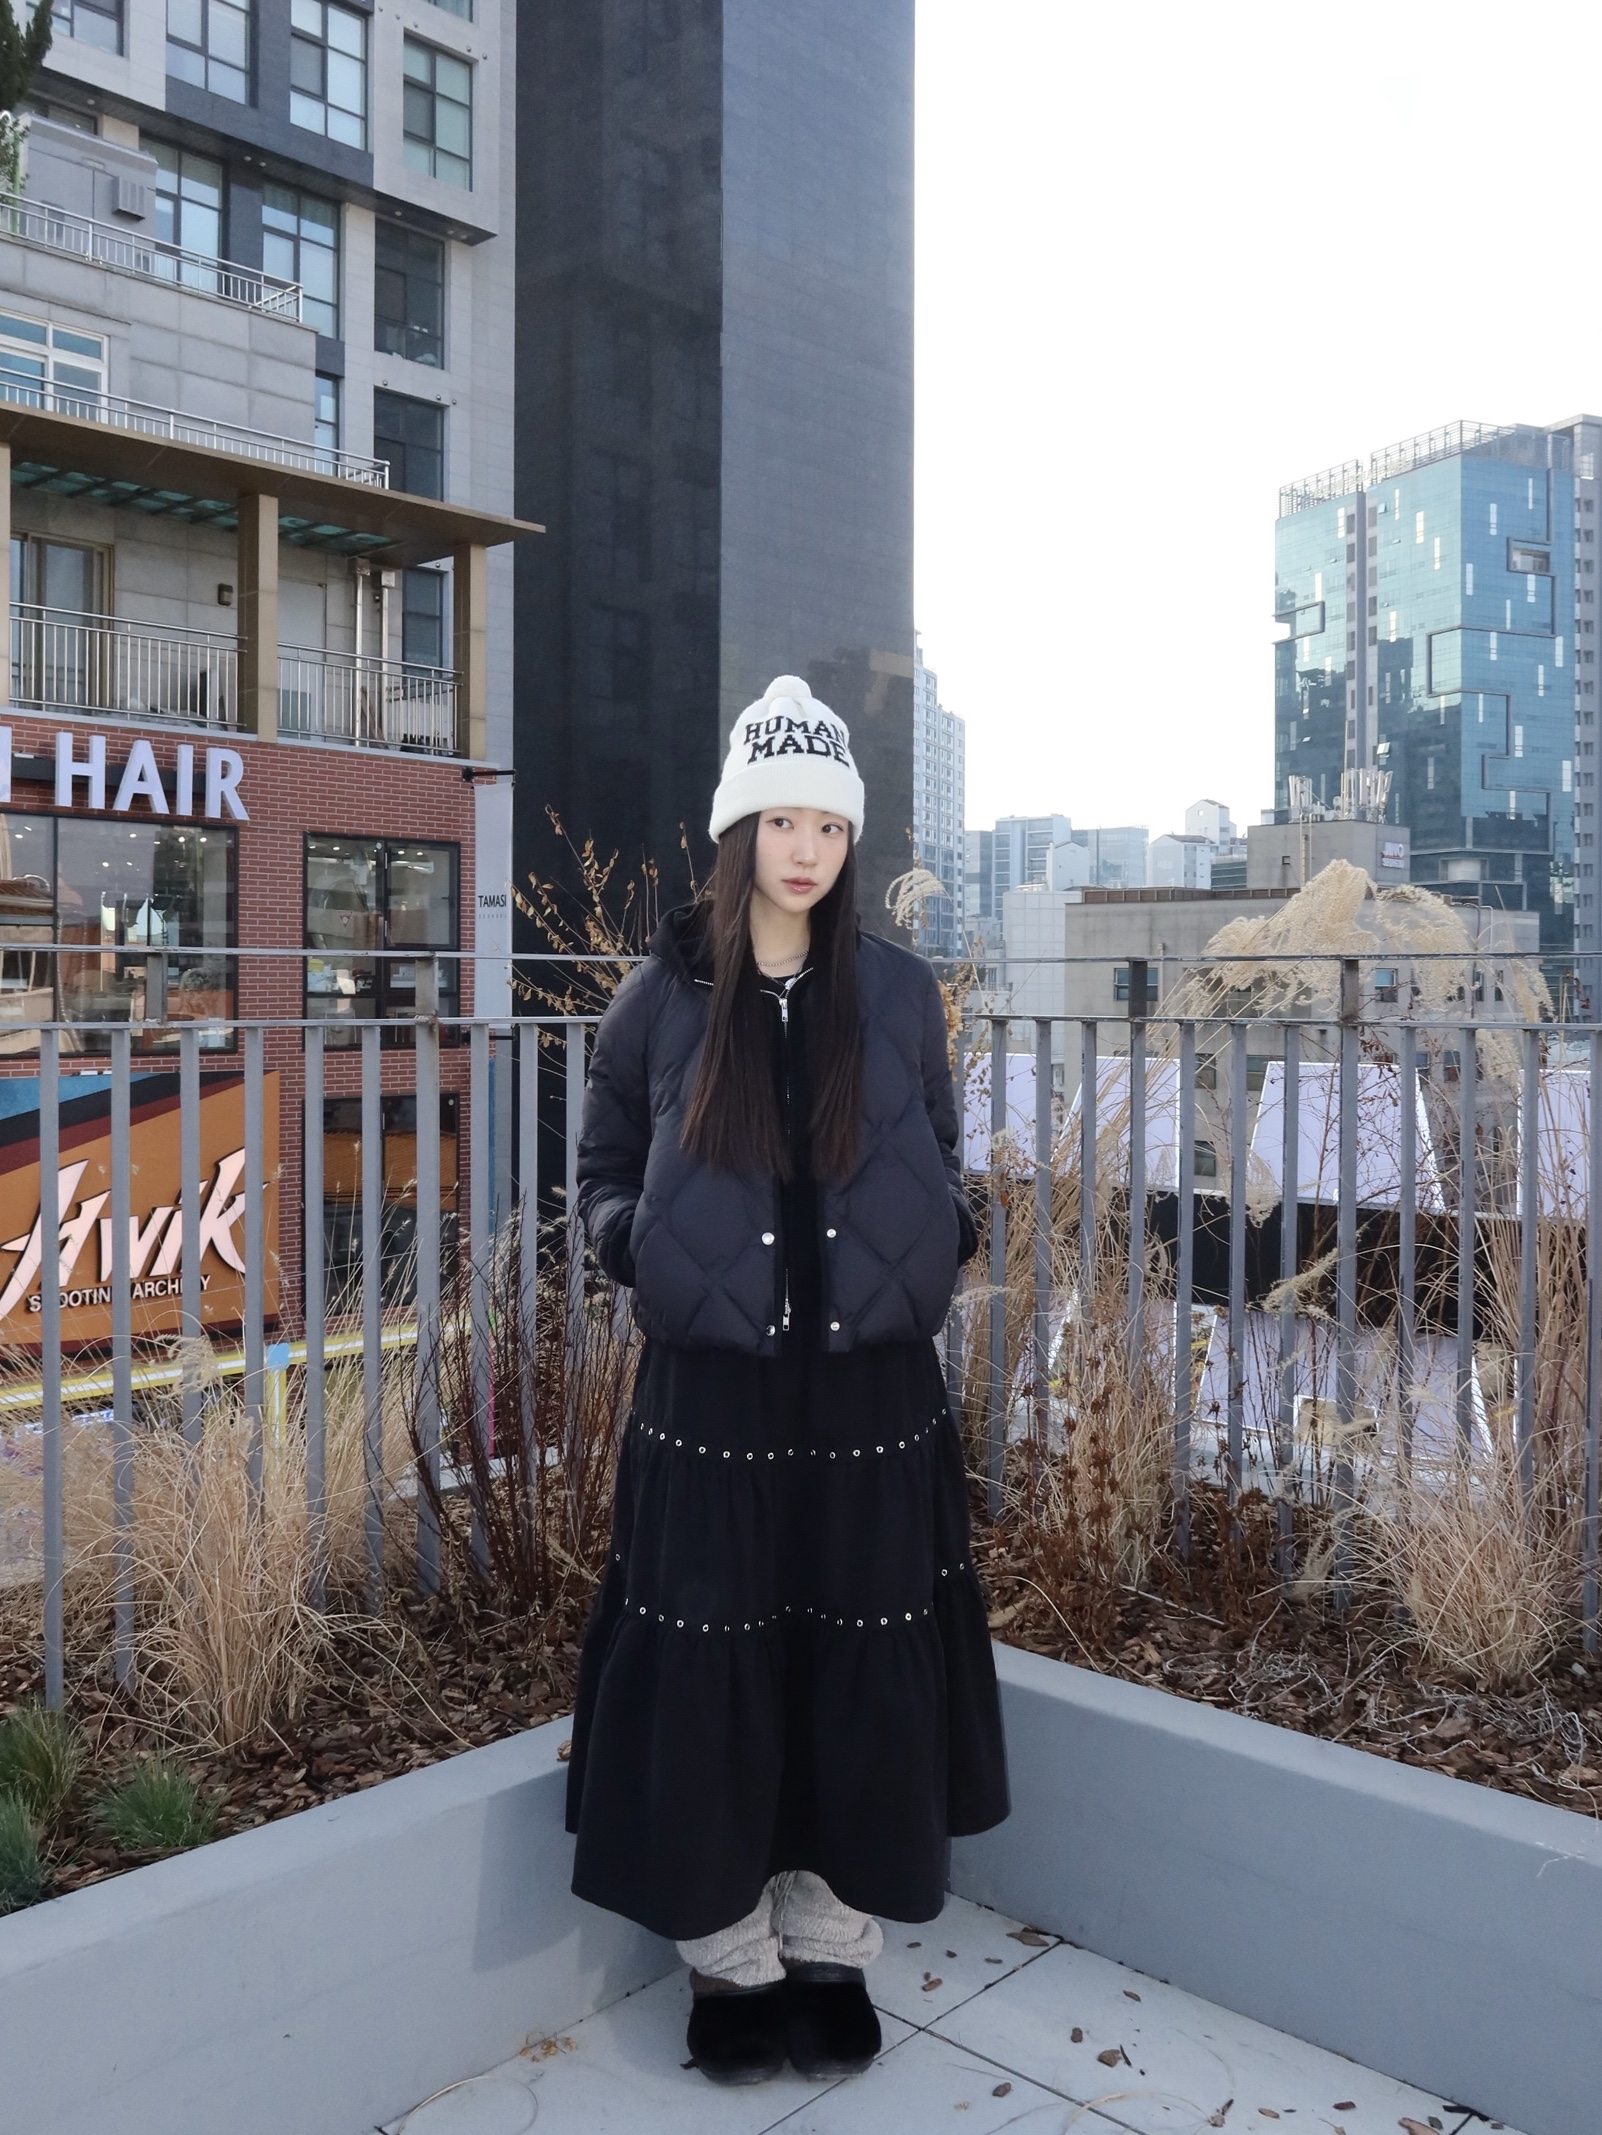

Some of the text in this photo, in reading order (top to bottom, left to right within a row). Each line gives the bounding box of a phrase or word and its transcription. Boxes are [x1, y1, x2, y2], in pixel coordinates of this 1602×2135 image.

[744, 716, 848, 750] HUMAN
[747, 735, 850, 768] MADE
[55, 731, 250, 820] HAIR
[478, 894, 507, 908] TAMASI
[28, 1275, 211, 1312] SOOTIN ARCHY
